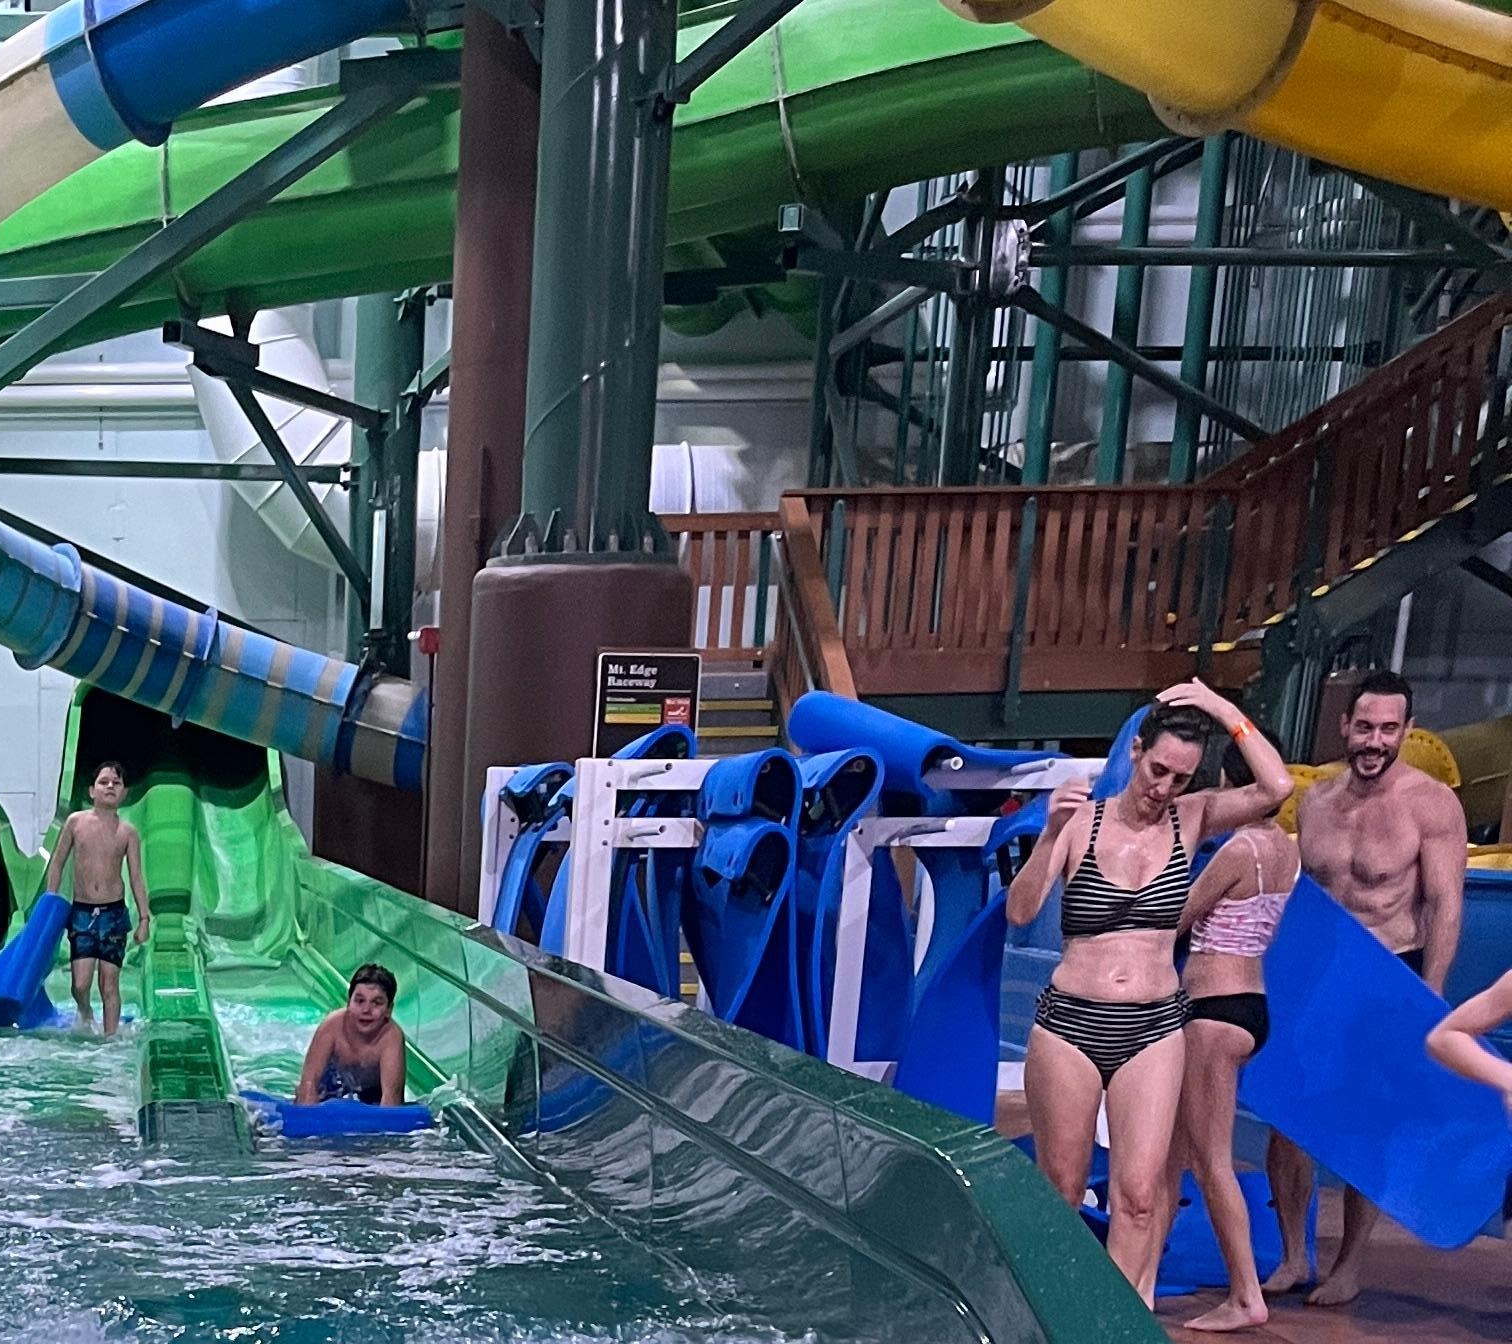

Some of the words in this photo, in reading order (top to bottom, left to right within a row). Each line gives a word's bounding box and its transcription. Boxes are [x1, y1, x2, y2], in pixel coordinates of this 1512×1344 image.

[608, 664, 626, 675] Mt.
[630, 664, 657, 677] Edge
[608, 676, 657, 688] Raceway
